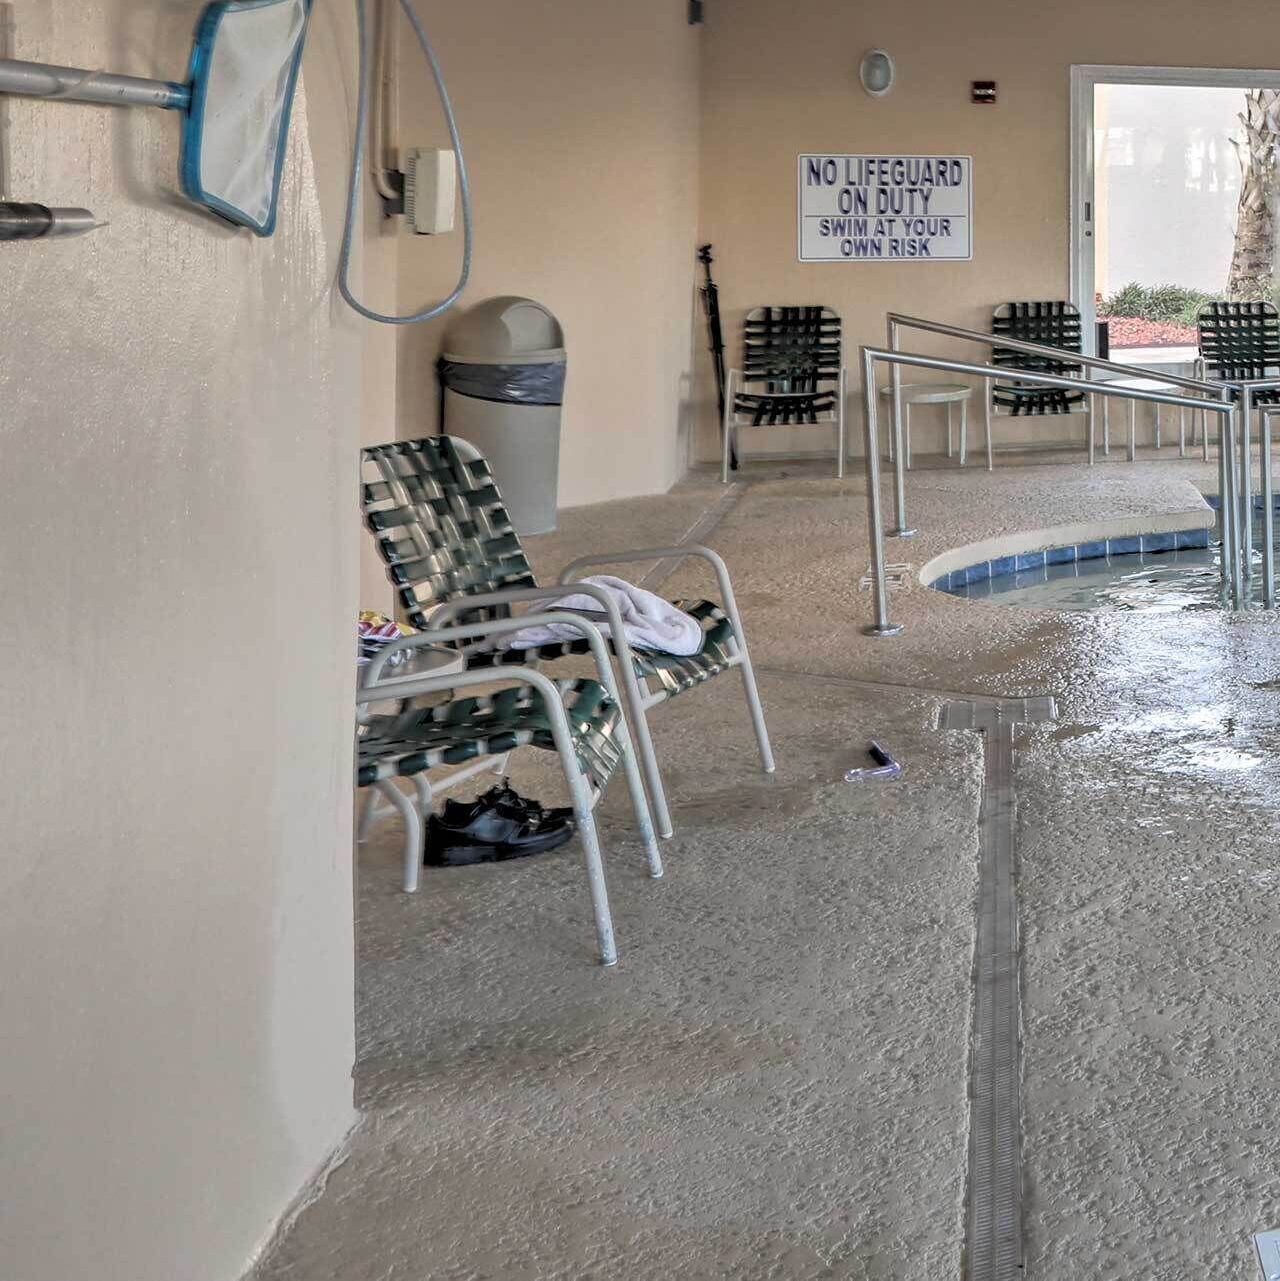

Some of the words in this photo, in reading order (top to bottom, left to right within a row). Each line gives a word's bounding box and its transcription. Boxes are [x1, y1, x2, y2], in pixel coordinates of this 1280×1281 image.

[807, 158, 838, 186] NO
[845, 159, 962, 187] LIFEGUARD
[837, 188, 868, 215] ON
[876, 188, 933, 215] DUTY
[819, 218, 867, 237] SWIM
[873, 218, 896, 237] AT
[901, 218, 952, 237] YOUR
[840, 238, 882, 257] OWN
[888, 238, 932, 257] RISK
